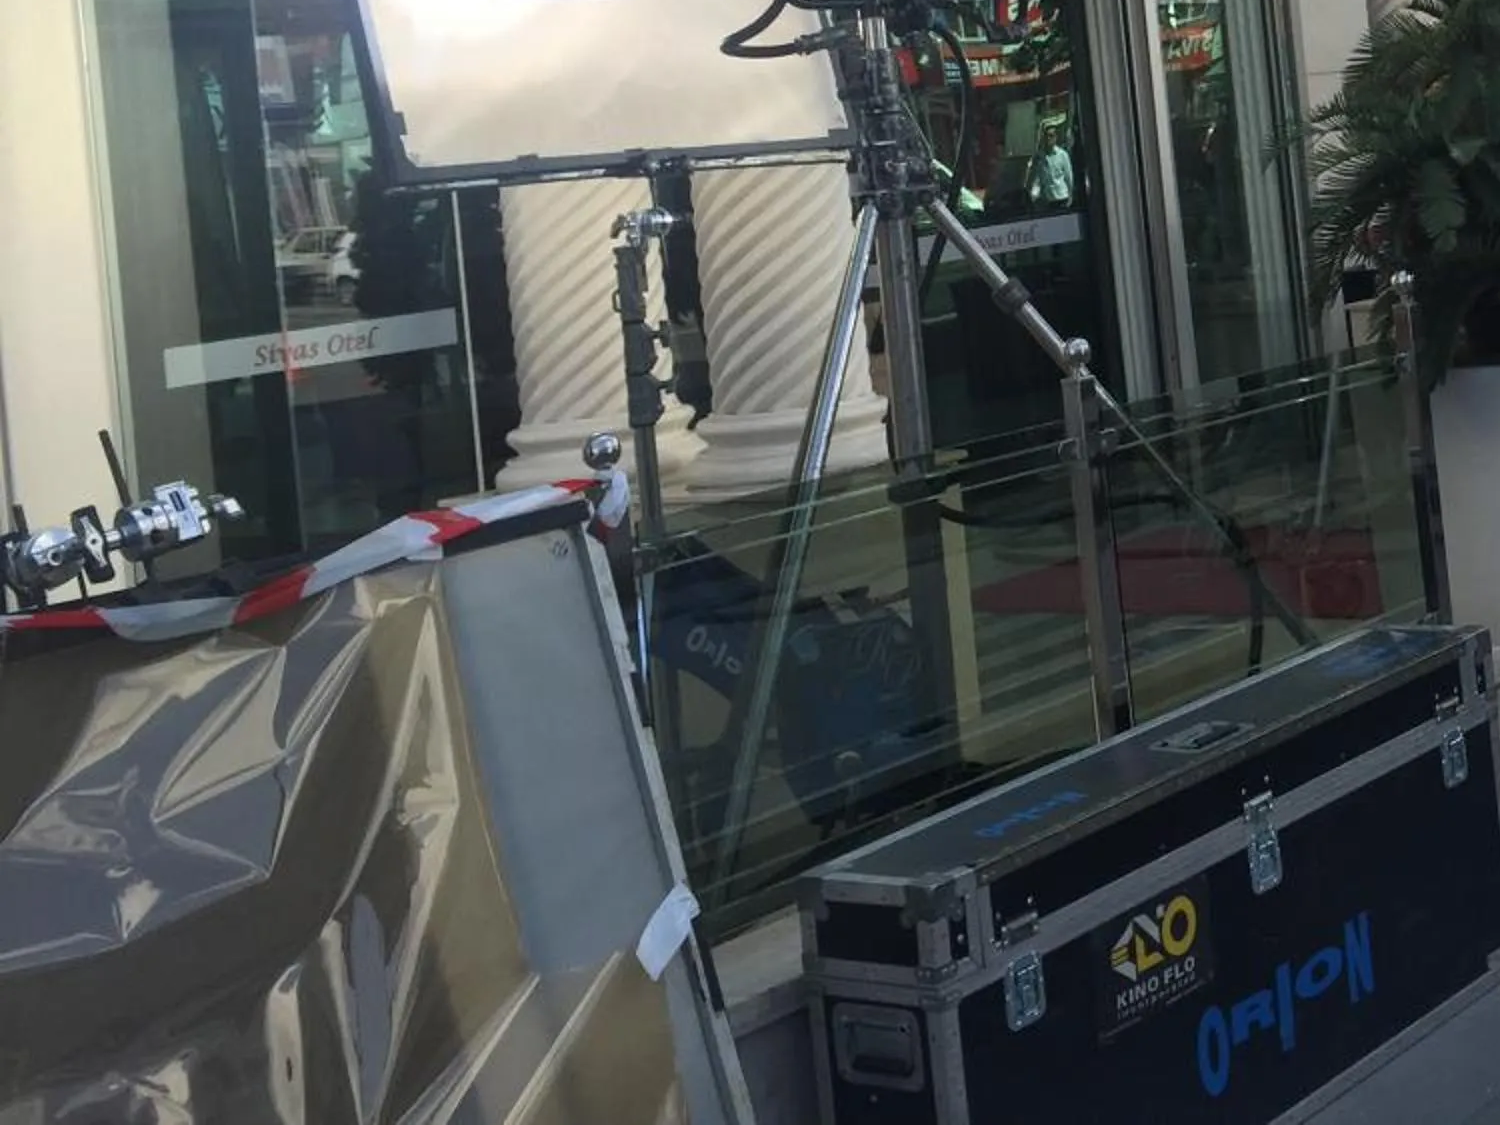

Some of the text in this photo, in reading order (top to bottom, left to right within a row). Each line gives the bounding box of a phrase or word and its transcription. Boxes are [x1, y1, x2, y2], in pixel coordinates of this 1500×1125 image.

[254, 326, 380, 366] Sivas Otel
[1116, 976, 1160, 1010] KINO
[1163, 955, 1196, 985] FLO
